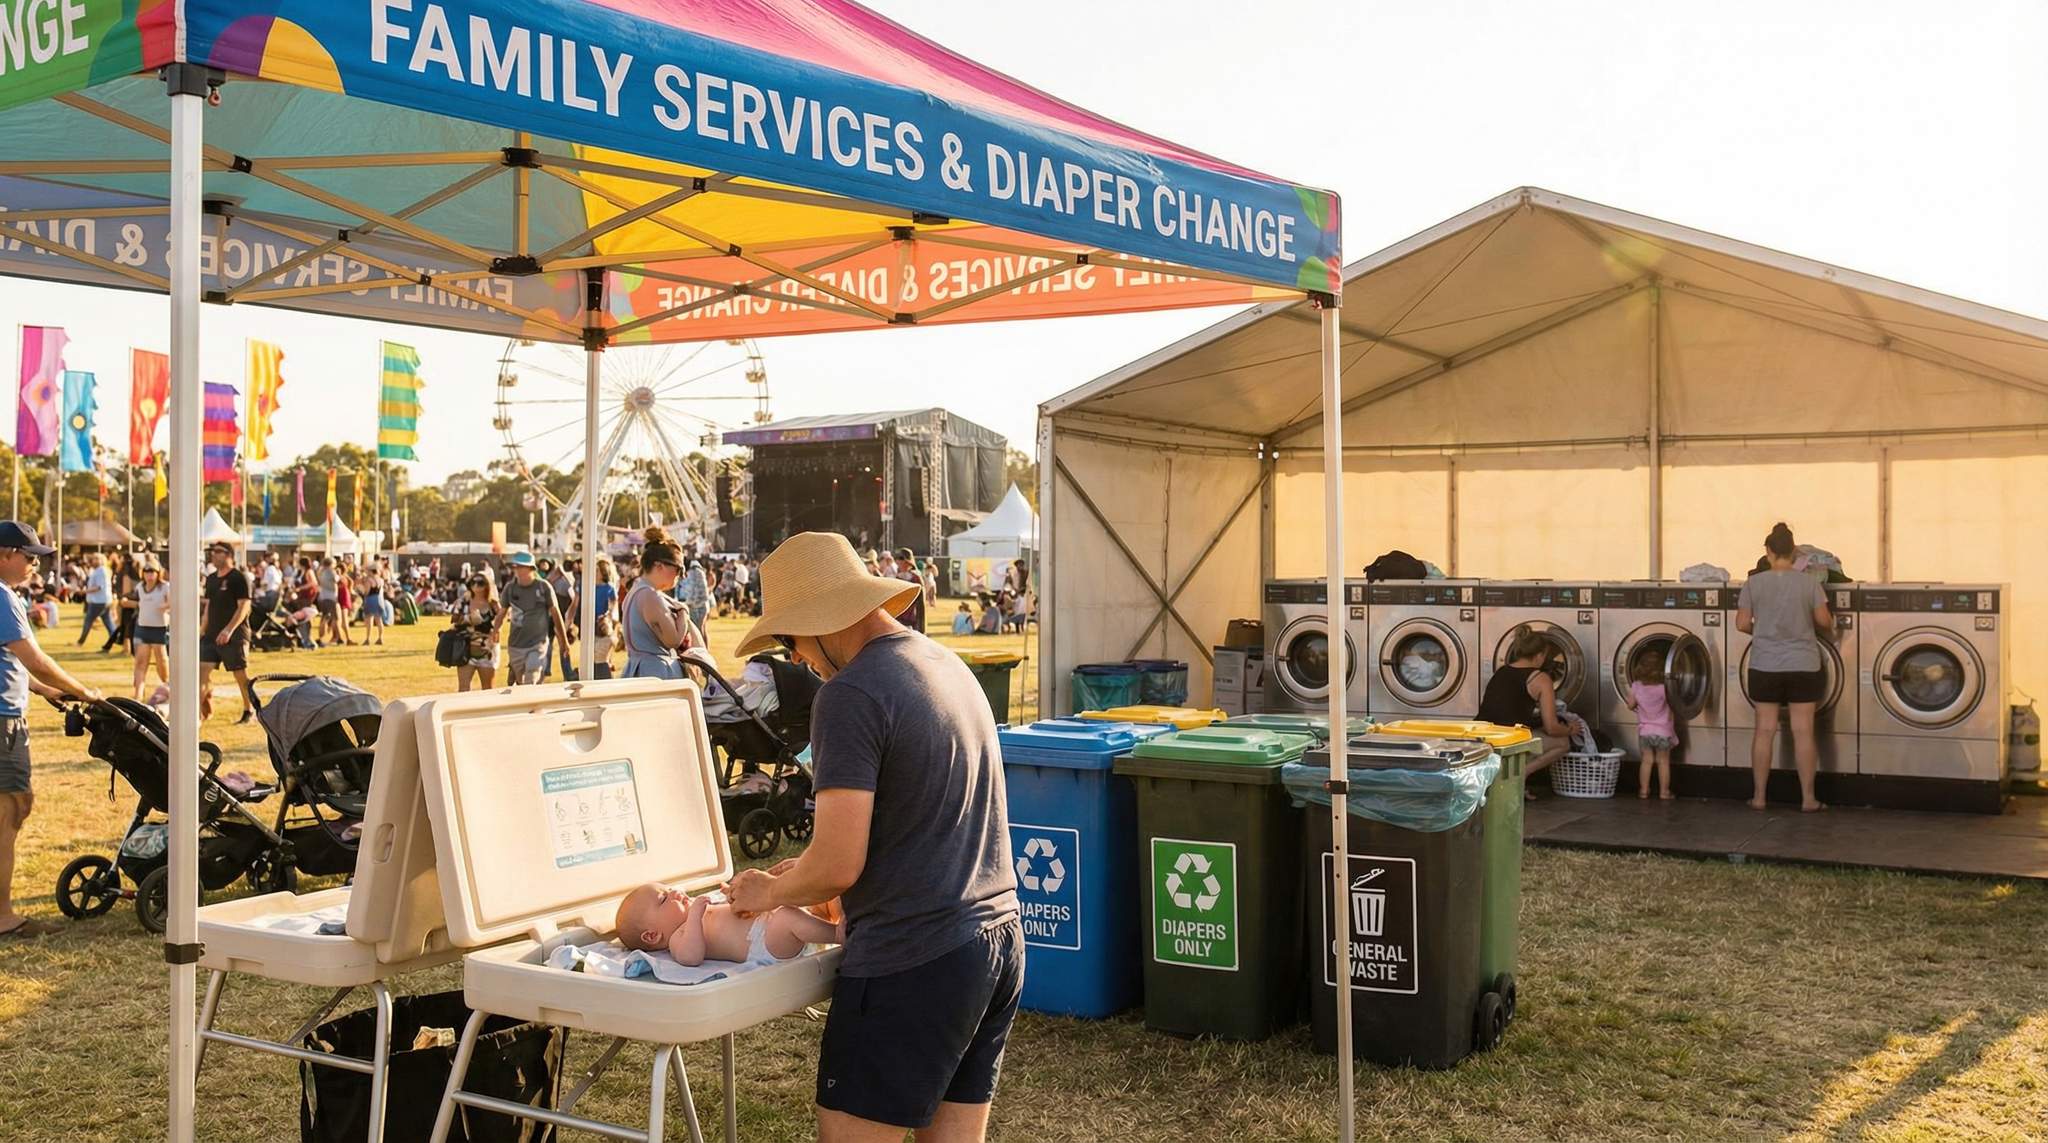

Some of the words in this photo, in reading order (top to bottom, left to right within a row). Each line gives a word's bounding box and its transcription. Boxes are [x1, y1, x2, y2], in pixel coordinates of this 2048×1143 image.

[371, 0, 634, 118] FAMILY
[653, 63, 925, 181] SERVICES
[941, 131, 974, 193] &
[987, 144, 1142, 230] DIAPER
[1153, 185, 1297, 263] CHANGE
[1021, 901, 1071, 921] IAPERS
[1024, 919, 1058, 938] ONLY
[1162, 918, 1227, 941] DIAPERS
[1174, 938, 1213, 958] ONLY
